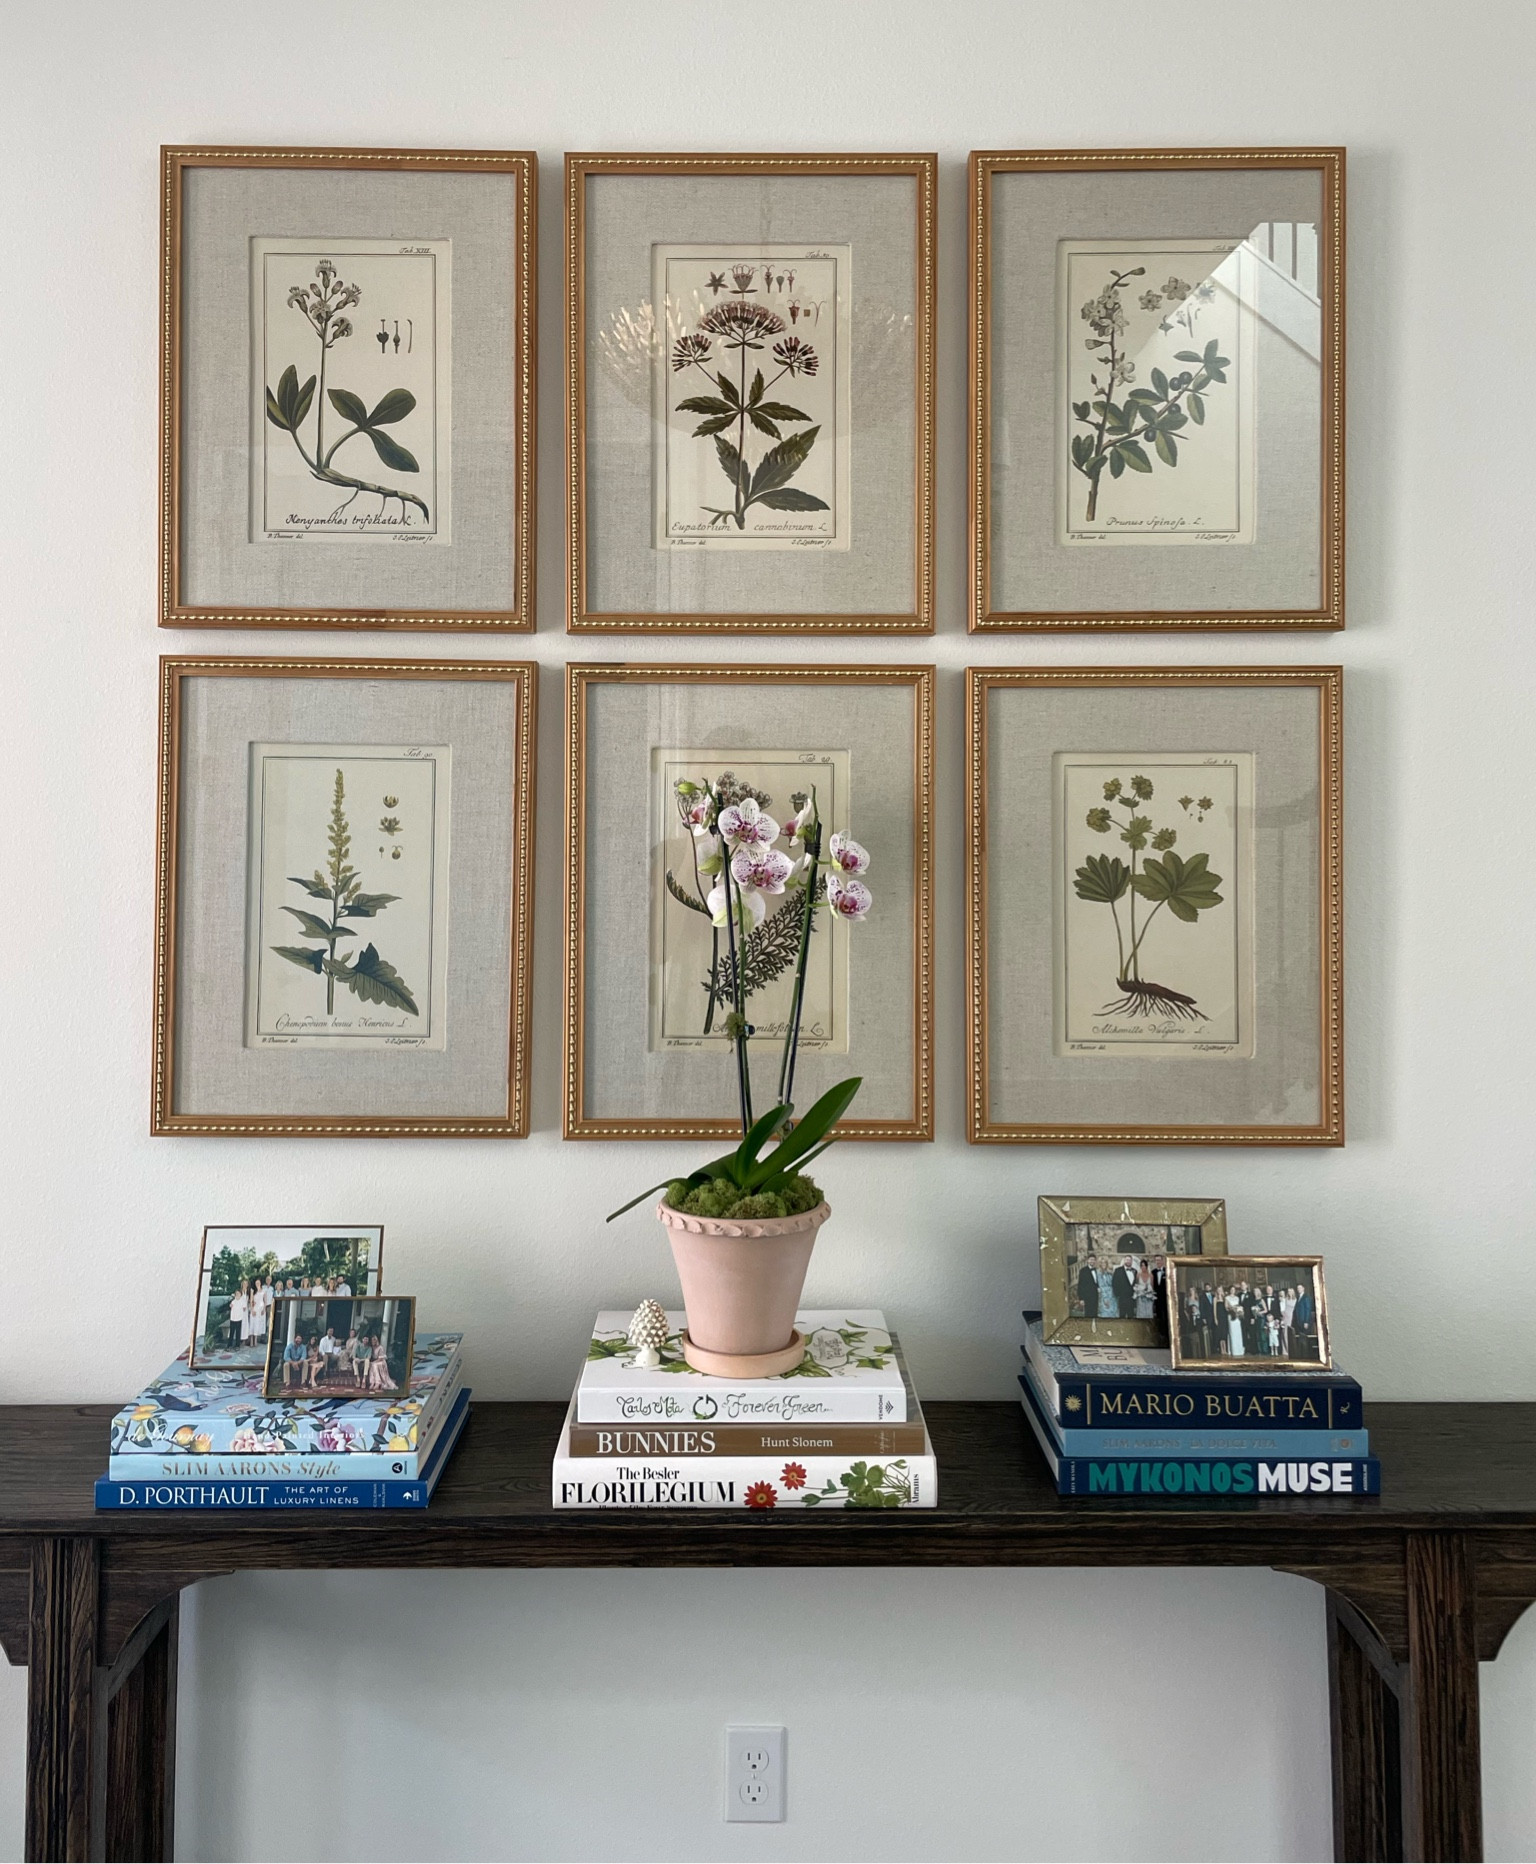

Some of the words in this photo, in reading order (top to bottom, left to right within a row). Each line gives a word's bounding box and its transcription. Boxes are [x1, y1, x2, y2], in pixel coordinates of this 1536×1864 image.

[285, 513, 348, 530] Menyanthes
[671, 521, 731, 532] Eupatorium
[1106, 516, 1144, 526] Prunus
[1100, 1392, 1195, 1416] MARIO
[1205, 1394, 1319, 1418] BUATTA
[596, 1431, 716, 1454] BUNNIES
[761, 1436, 791, 1447] Hunt
[792, 1436, 833, 1447] Slonem
[1103, 1438, 1130, 1449] SLIM
[162, 1461, 208, 1476] SLIM
[214, 1461, 291, 1476] AARONS
[297, 1460, 341, 1479] Style
[616, 1467, 640, 1480] The
[643, 1467, 680, 1480] Besler
[1089, 1462, 1254, 1493] MYKONOS
[1258, 1461, 1353, 1493] MUSE
[119, 1486, 140, 1505] D.
[145, 1486, 270, 1505] PORTHAULT
[284, 1486, 305, 1494] THE
[309, 1486, 330, 1494] ART
[334, 1486, 349, 1494] OF
[560, 1481, 736, 1503] FLORILEGIUM
[911, 1473, 919, 1503] Abrams
[274, 1497, 316, 1505] LUXURY
[319, 1497, 359, 1505] LINENS
